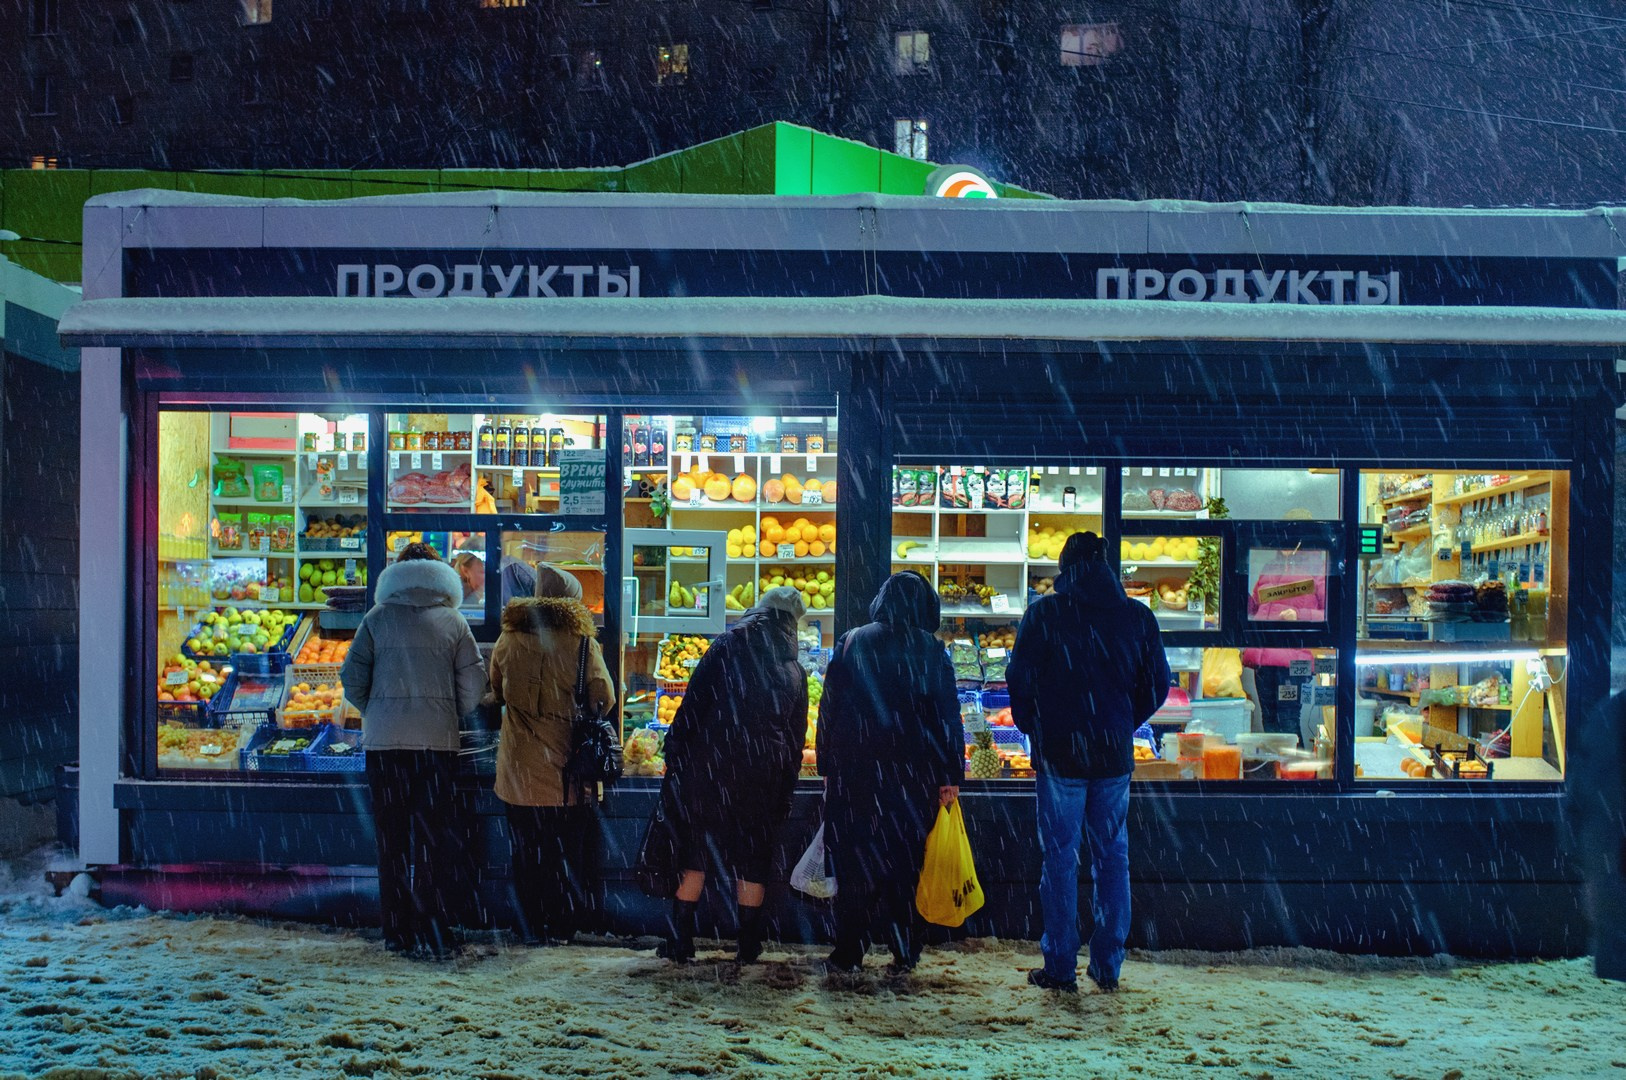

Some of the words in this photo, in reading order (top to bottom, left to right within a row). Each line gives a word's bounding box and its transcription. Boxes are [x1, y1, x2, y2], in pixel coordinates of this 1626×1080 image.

[337, 263, 640, 298] ПРОДУКТЫ
[1096, 268, 1400, 305] ПРОДУКТЫ
[560, 463, 606, 478] ВРЕМЯ
[560, 477, 606, 490] служить
[563, 495, 580, 506] 2,5
[1267, 585, 1307, 598] ЗАКРЫТО
